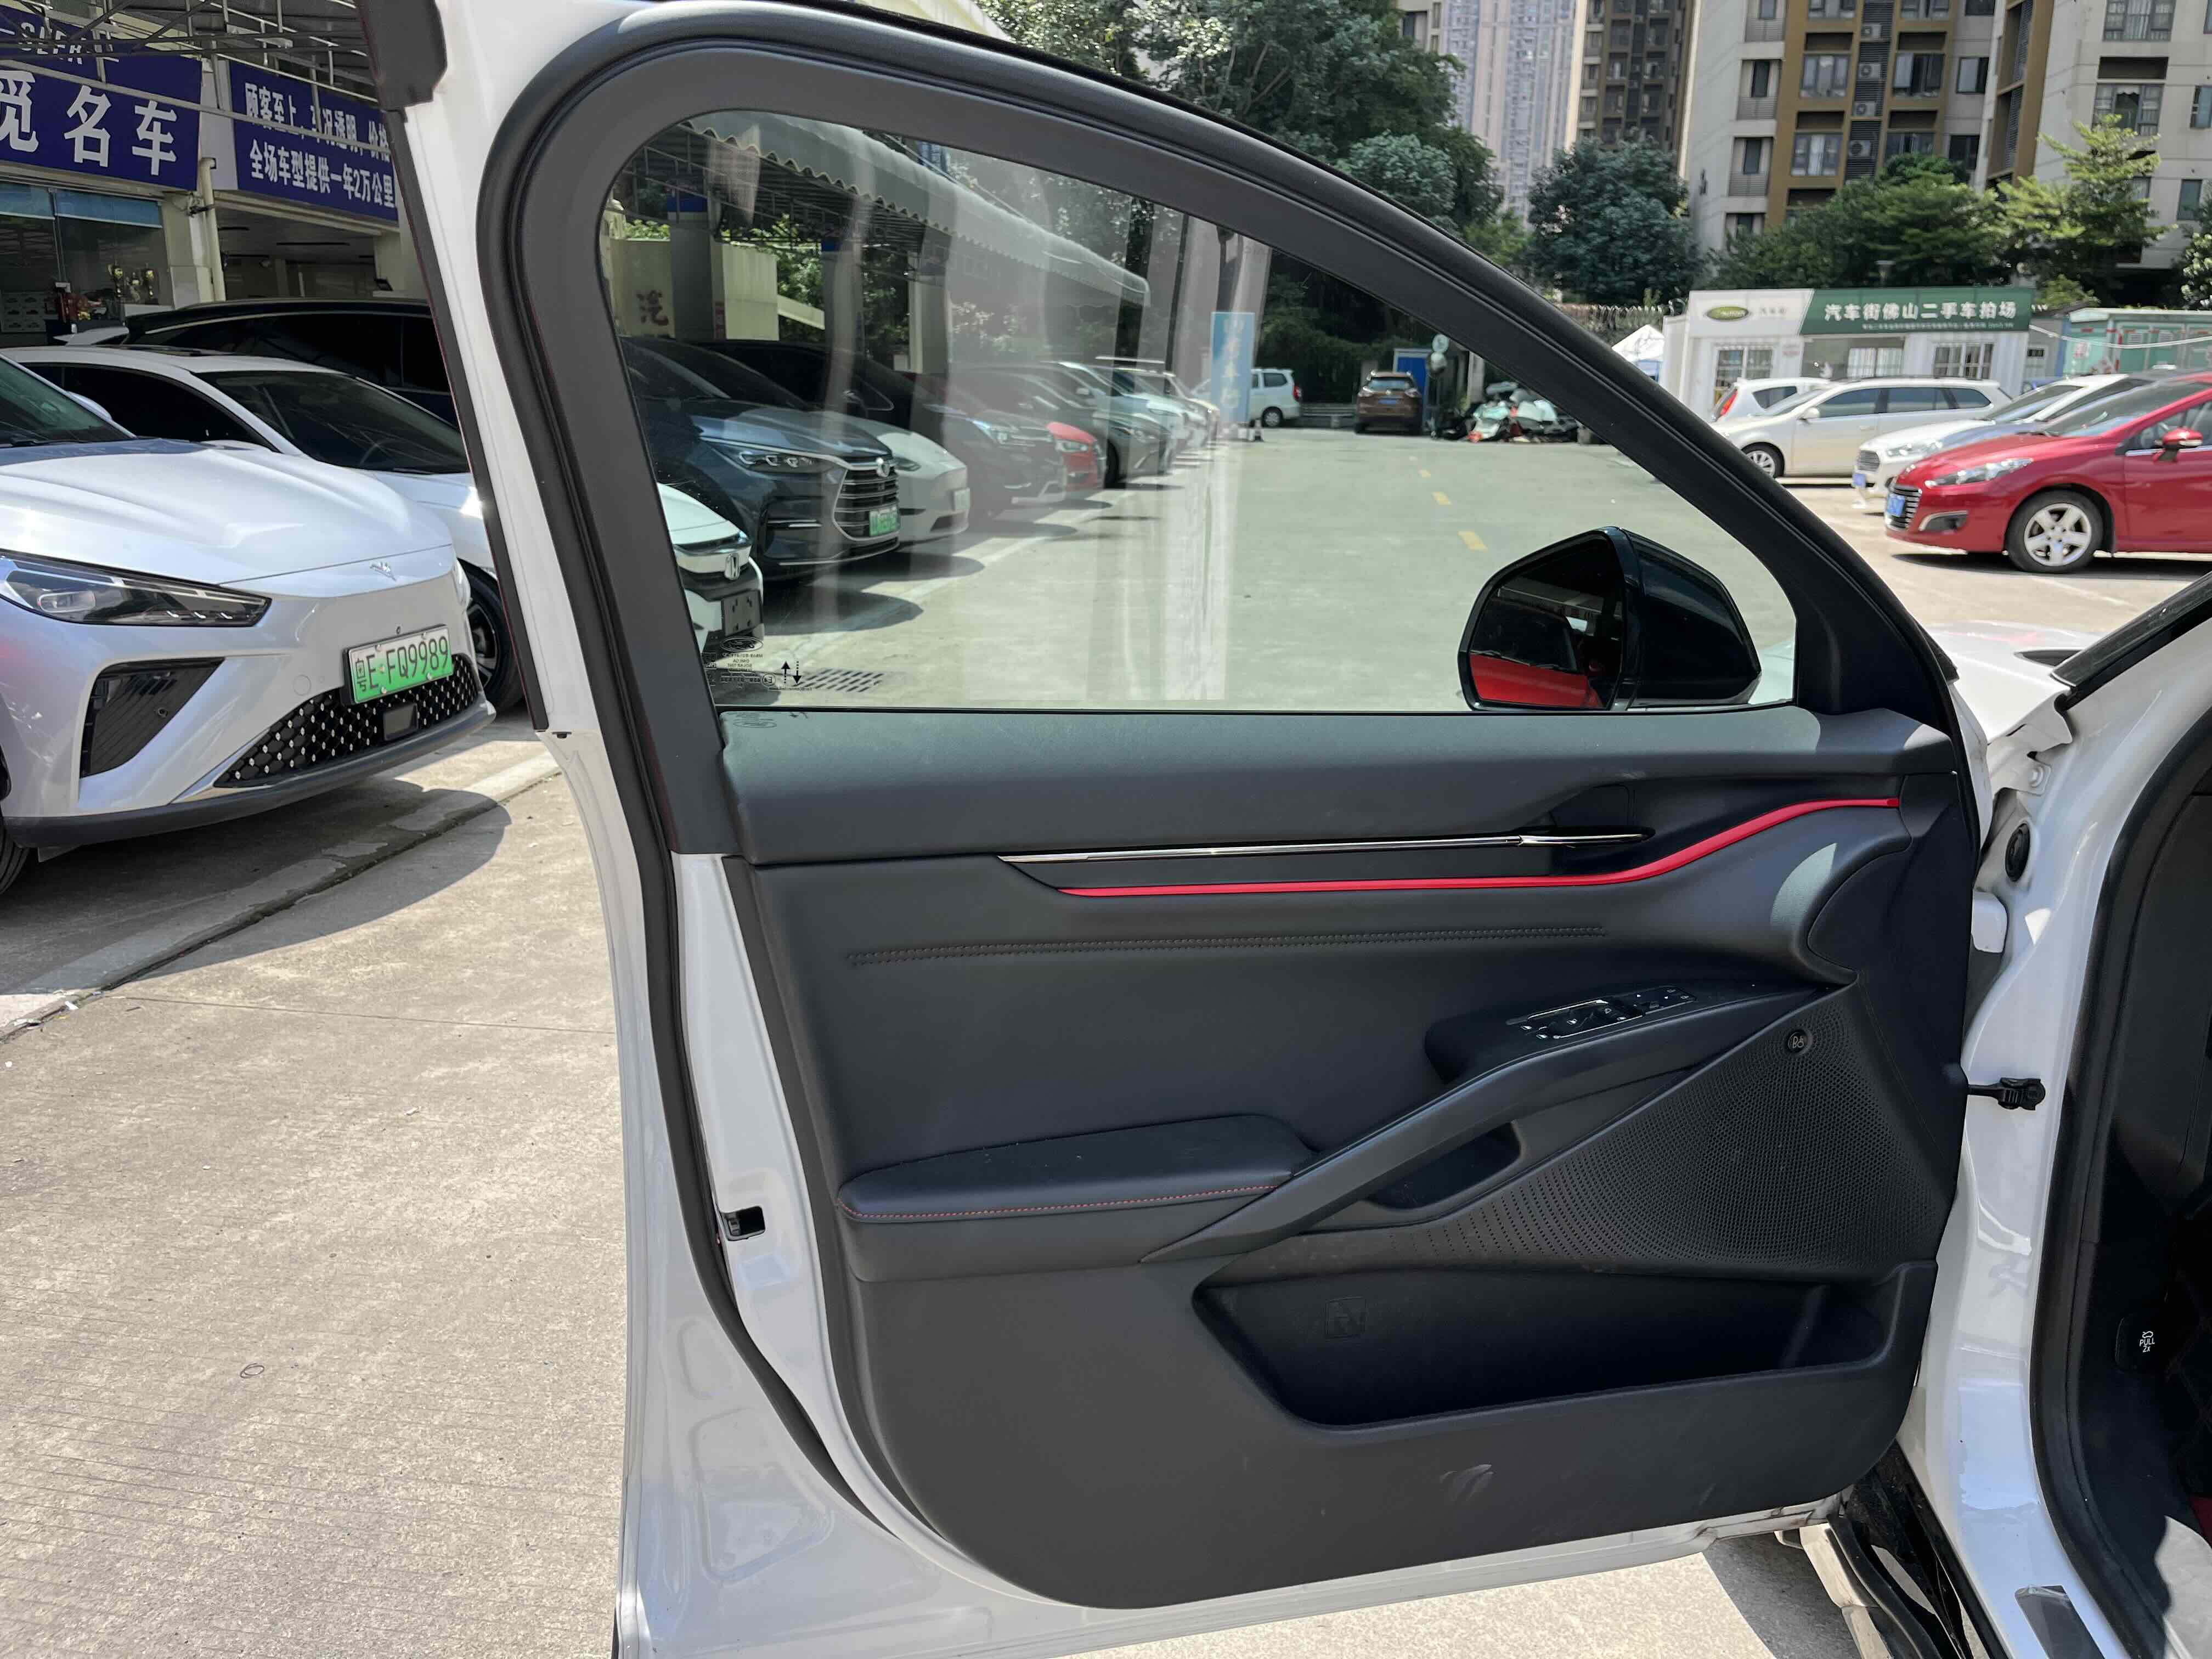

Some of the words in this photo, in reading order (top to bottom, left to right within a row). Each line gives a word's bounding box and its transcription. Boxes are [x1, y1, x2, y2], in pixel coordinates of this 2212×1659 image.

[250, 138, 395, 208] 全场车型提供一年2万公里
[1824, 301, 2017, 321] 汽车街佛山二手车拍场
[2139, 1337, 2155, 1347] PULL
